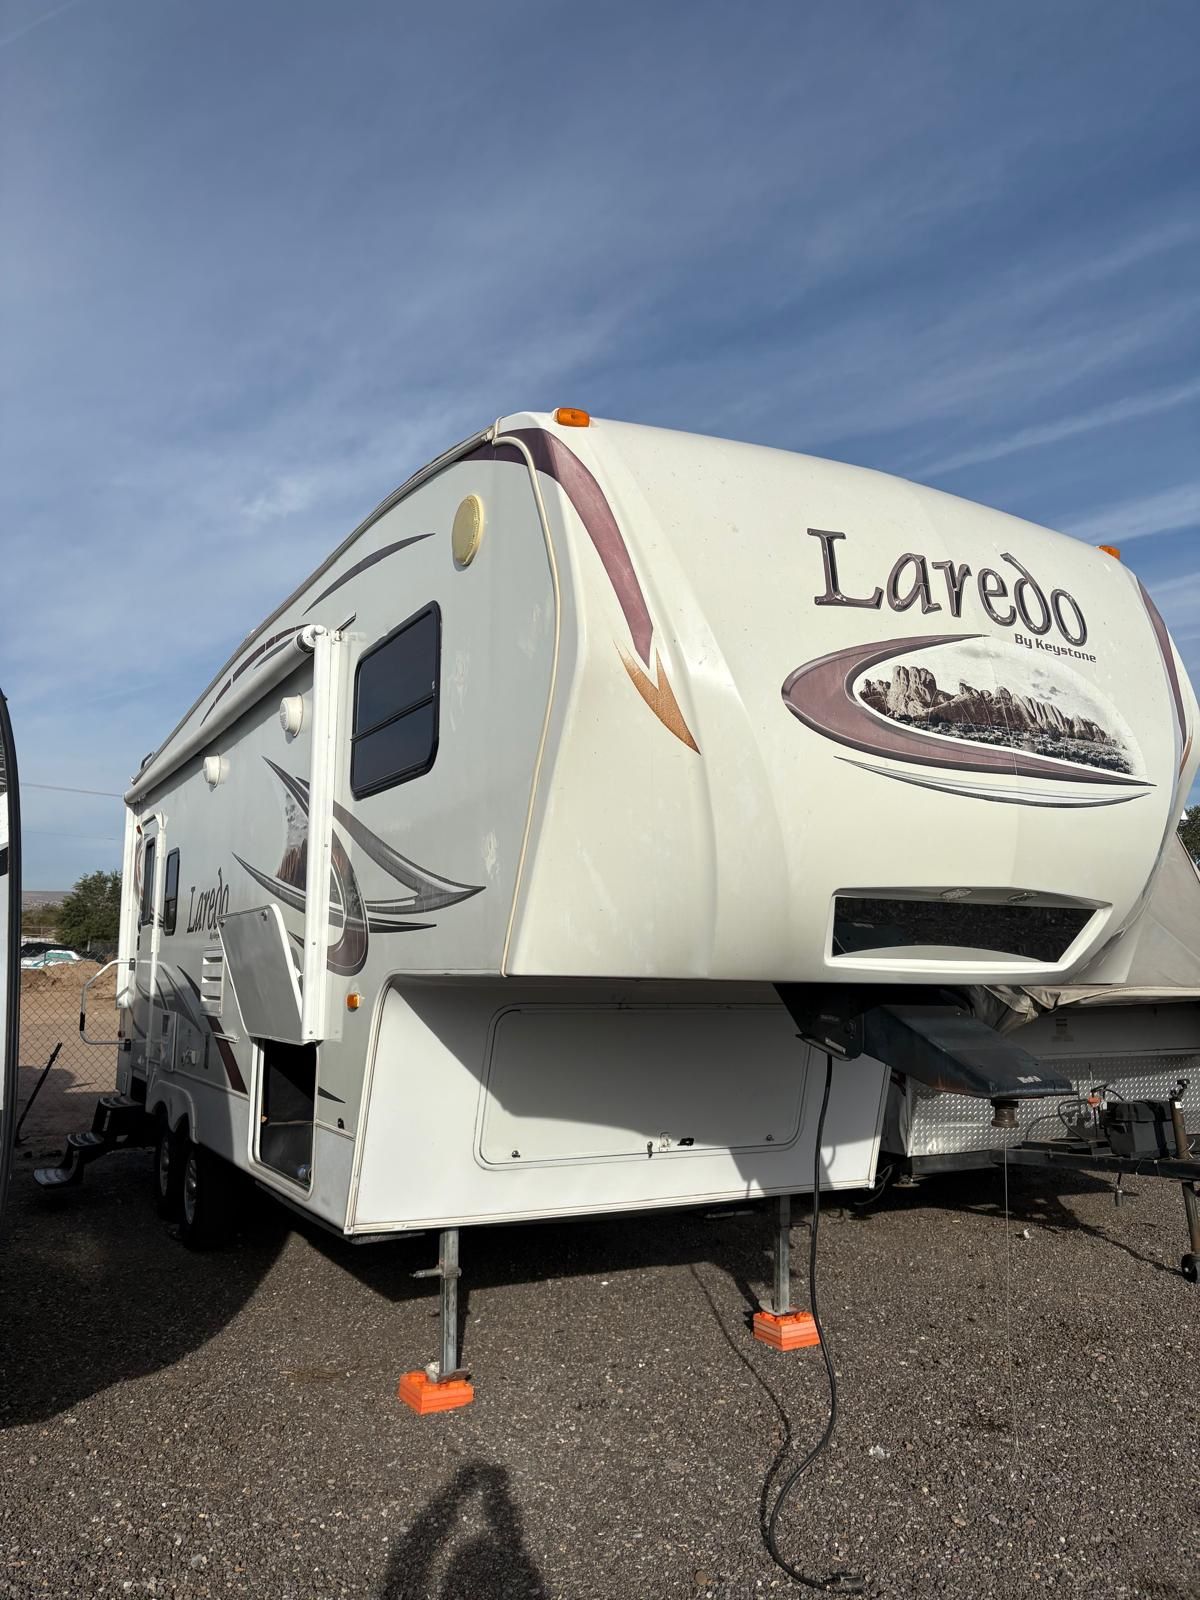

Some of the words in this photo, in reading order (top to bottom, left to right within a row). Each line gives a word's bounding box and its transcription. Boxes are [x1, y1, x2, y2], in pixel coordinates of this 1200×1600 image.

[807, 528, 1087, 647] Laredo
[1014, 633, 1033, 650] By
[1035, 638, 1097, 663] Keystone
[187, 867, 229, 933] Laredo
